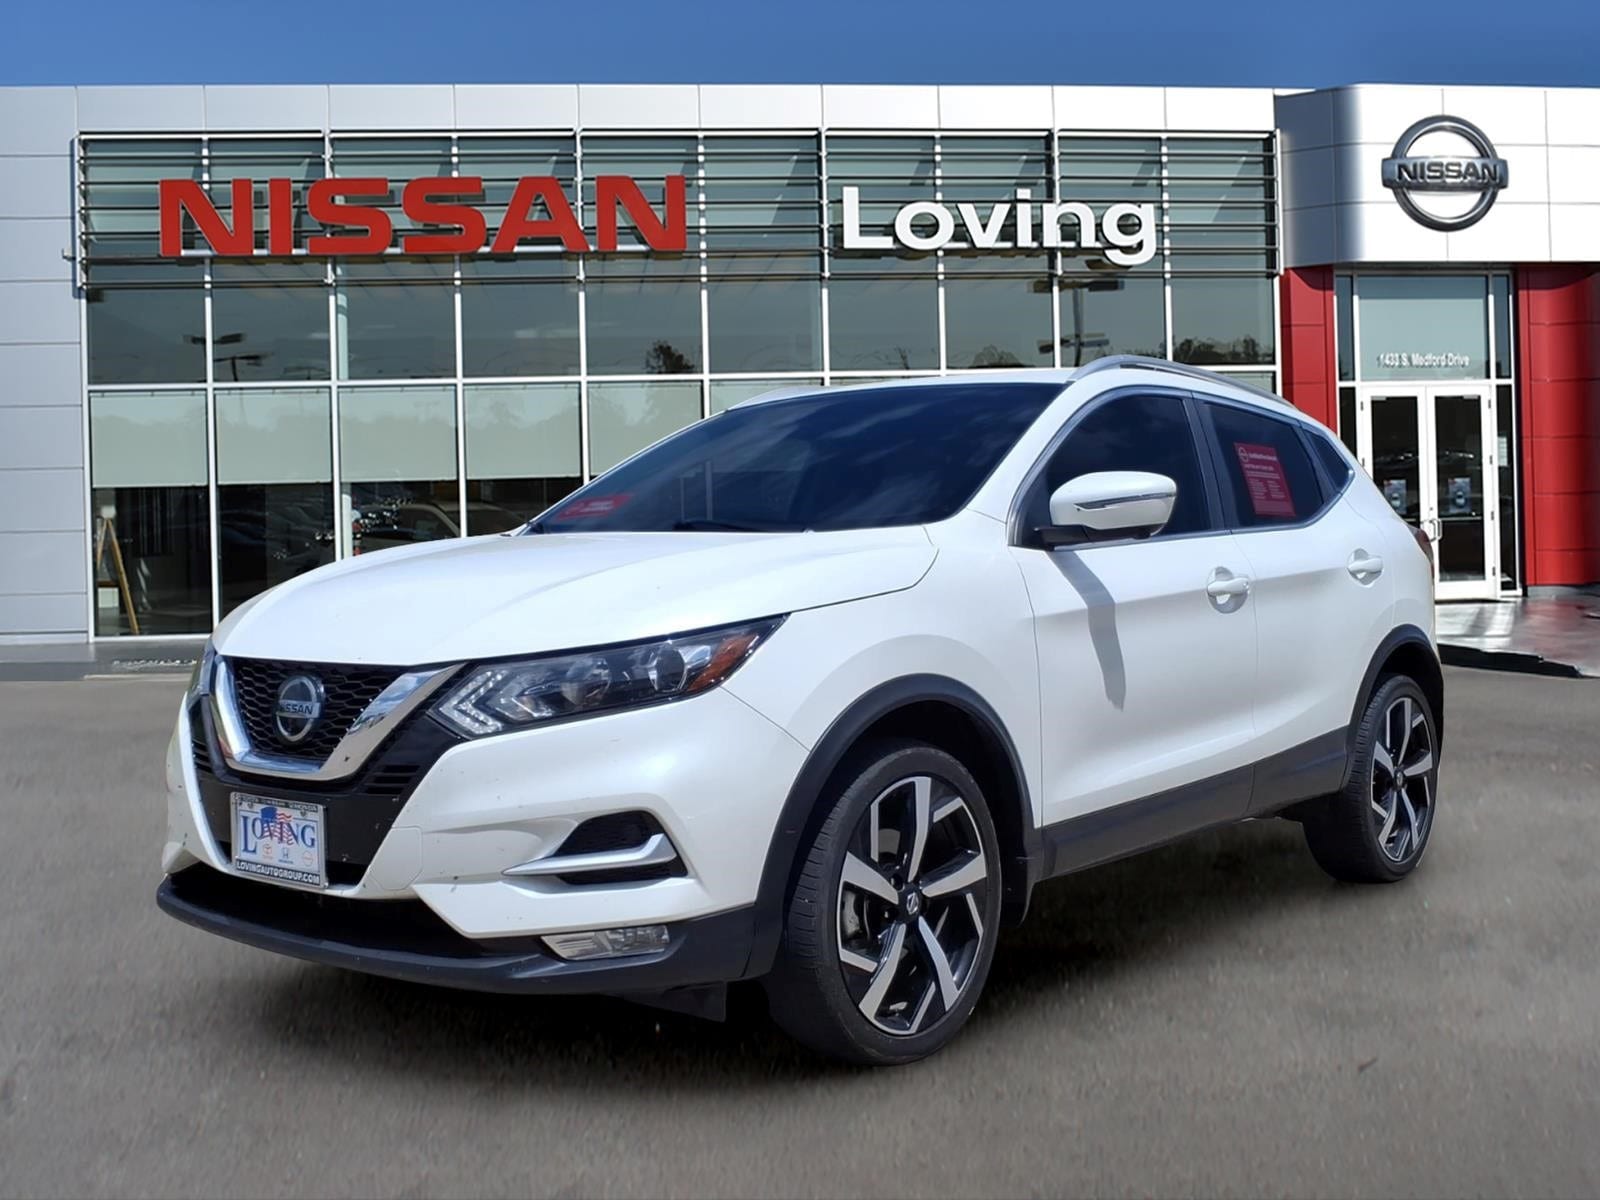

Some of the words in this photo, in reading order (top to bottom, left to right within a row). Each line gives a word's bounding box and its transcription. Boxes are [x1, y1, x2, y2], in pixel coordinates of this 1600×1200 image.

[1397, 160, 1498, 182] NISSAN
[158, 175, 688, 257] NISSAN
[842, 185, 1158, 267] Loving
[1447, 352, 1470, 367] Drive
[280, 702, 314, 715] SSAN
[240, 815, 317, 855] LOVING
[236, 861, 321, 885] LOVINGAUTOGROUP.COM
